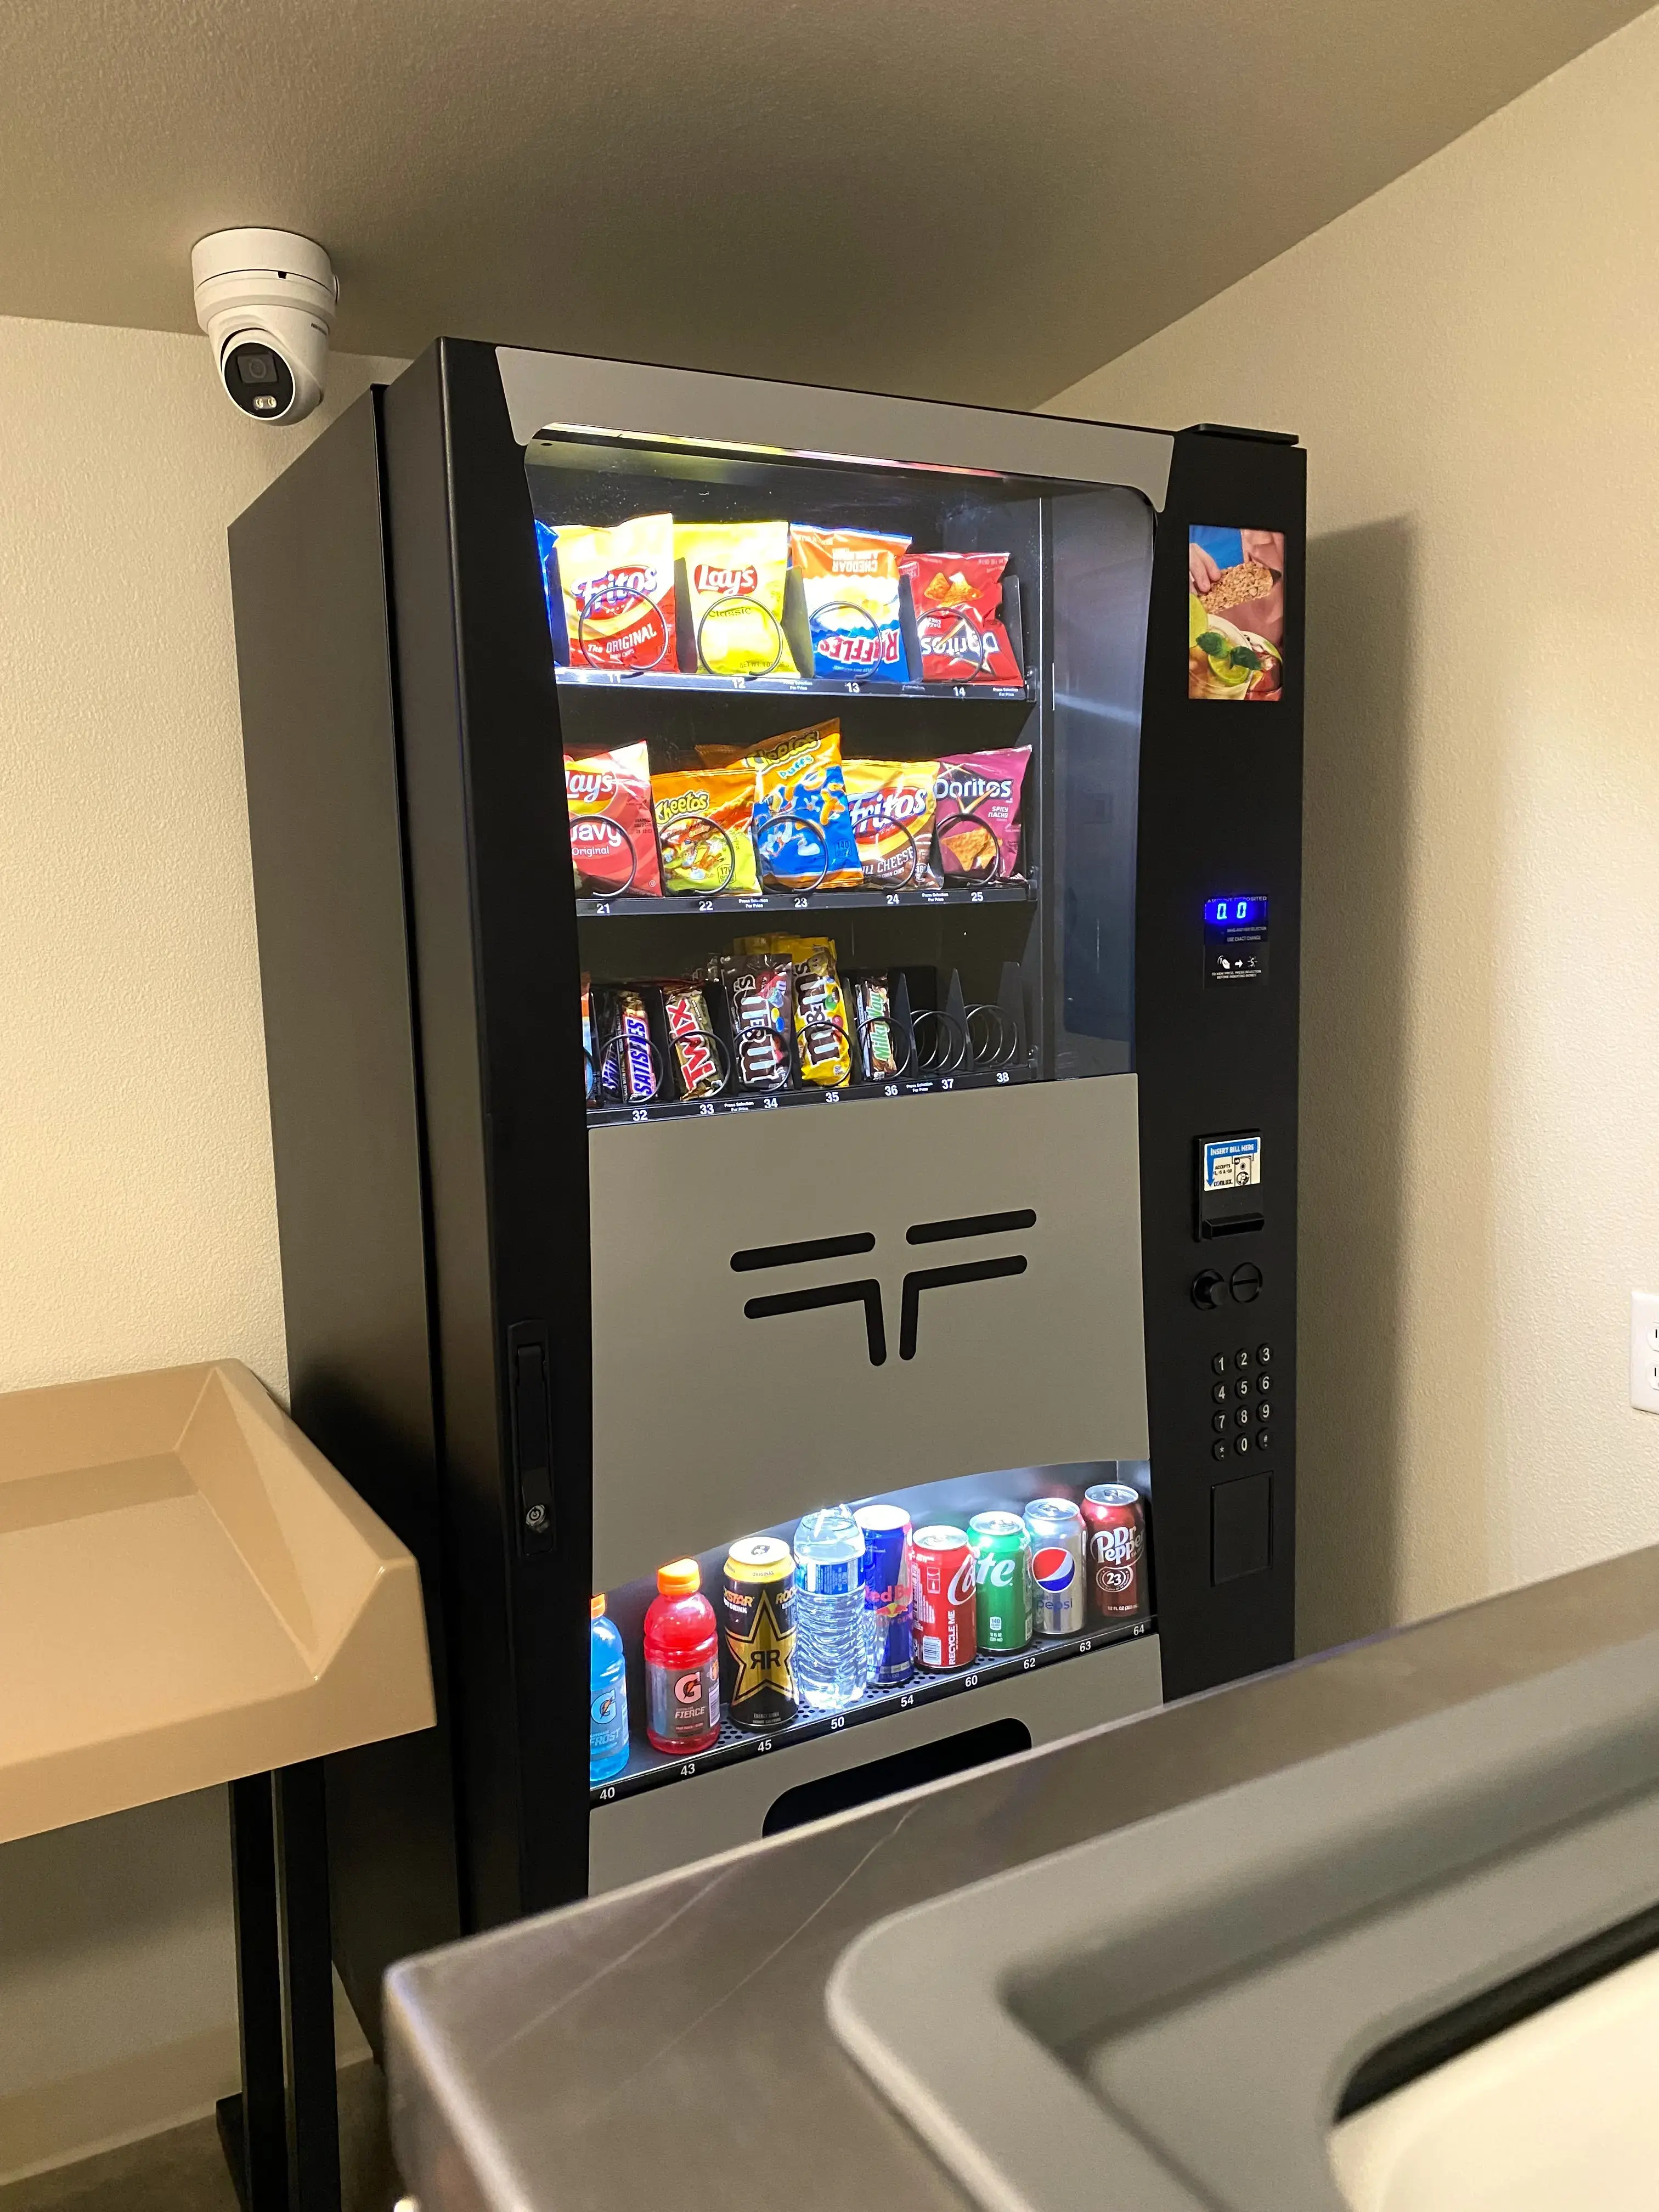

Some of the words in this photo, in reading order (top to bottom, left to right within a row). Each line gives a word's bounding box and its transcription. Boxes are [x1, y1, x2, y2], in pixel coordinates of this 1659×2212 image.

[832, 560, 878, 573] CHEDDAR
[571, 567, 657, 617] Fritos
[709, 608, 751, 617] Classic
[588, 644, 602, 653] The
[606, 623, 657, 653] ORIGINAL
[921, 631, 1000, 656] Doritos
[732, 678, 746, 689] 12
[847, 682, 860, 693] 13
[953, 687, 966, 697] 14
[935, 778, 1012, 798] Doritos
[656, 792, 709, 823] Cheetos
[848, 788, 927, 835] Fritos
[572, 845, 610, 857] Original
[878, 846, 914, 873] CHEESE
[887, 894, 899, 904] 24
[971, 891, 984, 901] 25
[596, 904, 610, 914] 21
[699, 901, 713, 911] 22
[794, 899, 808, 907] 23
[667, 998, 715, 1091] TWIX
[870, 1023, 891, 1062] Milky
[941, 1079, 954, 1089] 37
[997, 1072, 1009, 1083] 38
[826, 1092, 839, 1102] 35
[884, 1085, 898, 1096] 36
[699, 1104, 714, 1115] 33
[764, 1098, 778, 1109] 34
[633, 1109, 648, 1121] 32
[1210, 1147, 1229, 1156] INSERT
[1229, 1145, 1240, 1153] BILL
[1218, 1357, 1224, 1371] 1
[1241, 1352, 1247, 1365] 2
[1263, 1347, 1269, 1361] 3
[1218, 1386, 1225, 1399] 4
[1241, 1381, 1248, 1394] 5
[1262, 1376, 1269, 1389] 6
[1219, 1415, 1225, 1429] 7
[1241, 1410, 1248, 1423] 8
[1262, 1404, 1269, 1418] 9
[1242, 1438, 1247, 1451] 0
[1113, 1526, 1136, 1548] Dr
[1091, 1529, 1144, 1565] Pepper
[1107, 1572, 1121, 1585] 23
[729, 1605, 748, 1614] DRINK
[947, 1610, 956, 1624] ME
[1133, 1624, 1144, 1635] 64
[947, 1626, 956, 1665] RECYCLE
[1080, 1641, 1091, 1652] 63
[1024, 1658, 1036, 1669] 62
[965, 1675, 978, 1687] 60
[674, 1671, 702, 1705] G
[591, 1689, 617, 1725] G
[901, 1695, 914, 1707] 54
[675, 1706, 706, 1719] FIERCE
[831, 1716, 845, 1729] 50
[591, 1727, 621, 1745] FROST
[758, 1739, 772, 1752] 45
[680, 1763, 695, 1776] 43
[600, 1787, 615, 1799] 40
